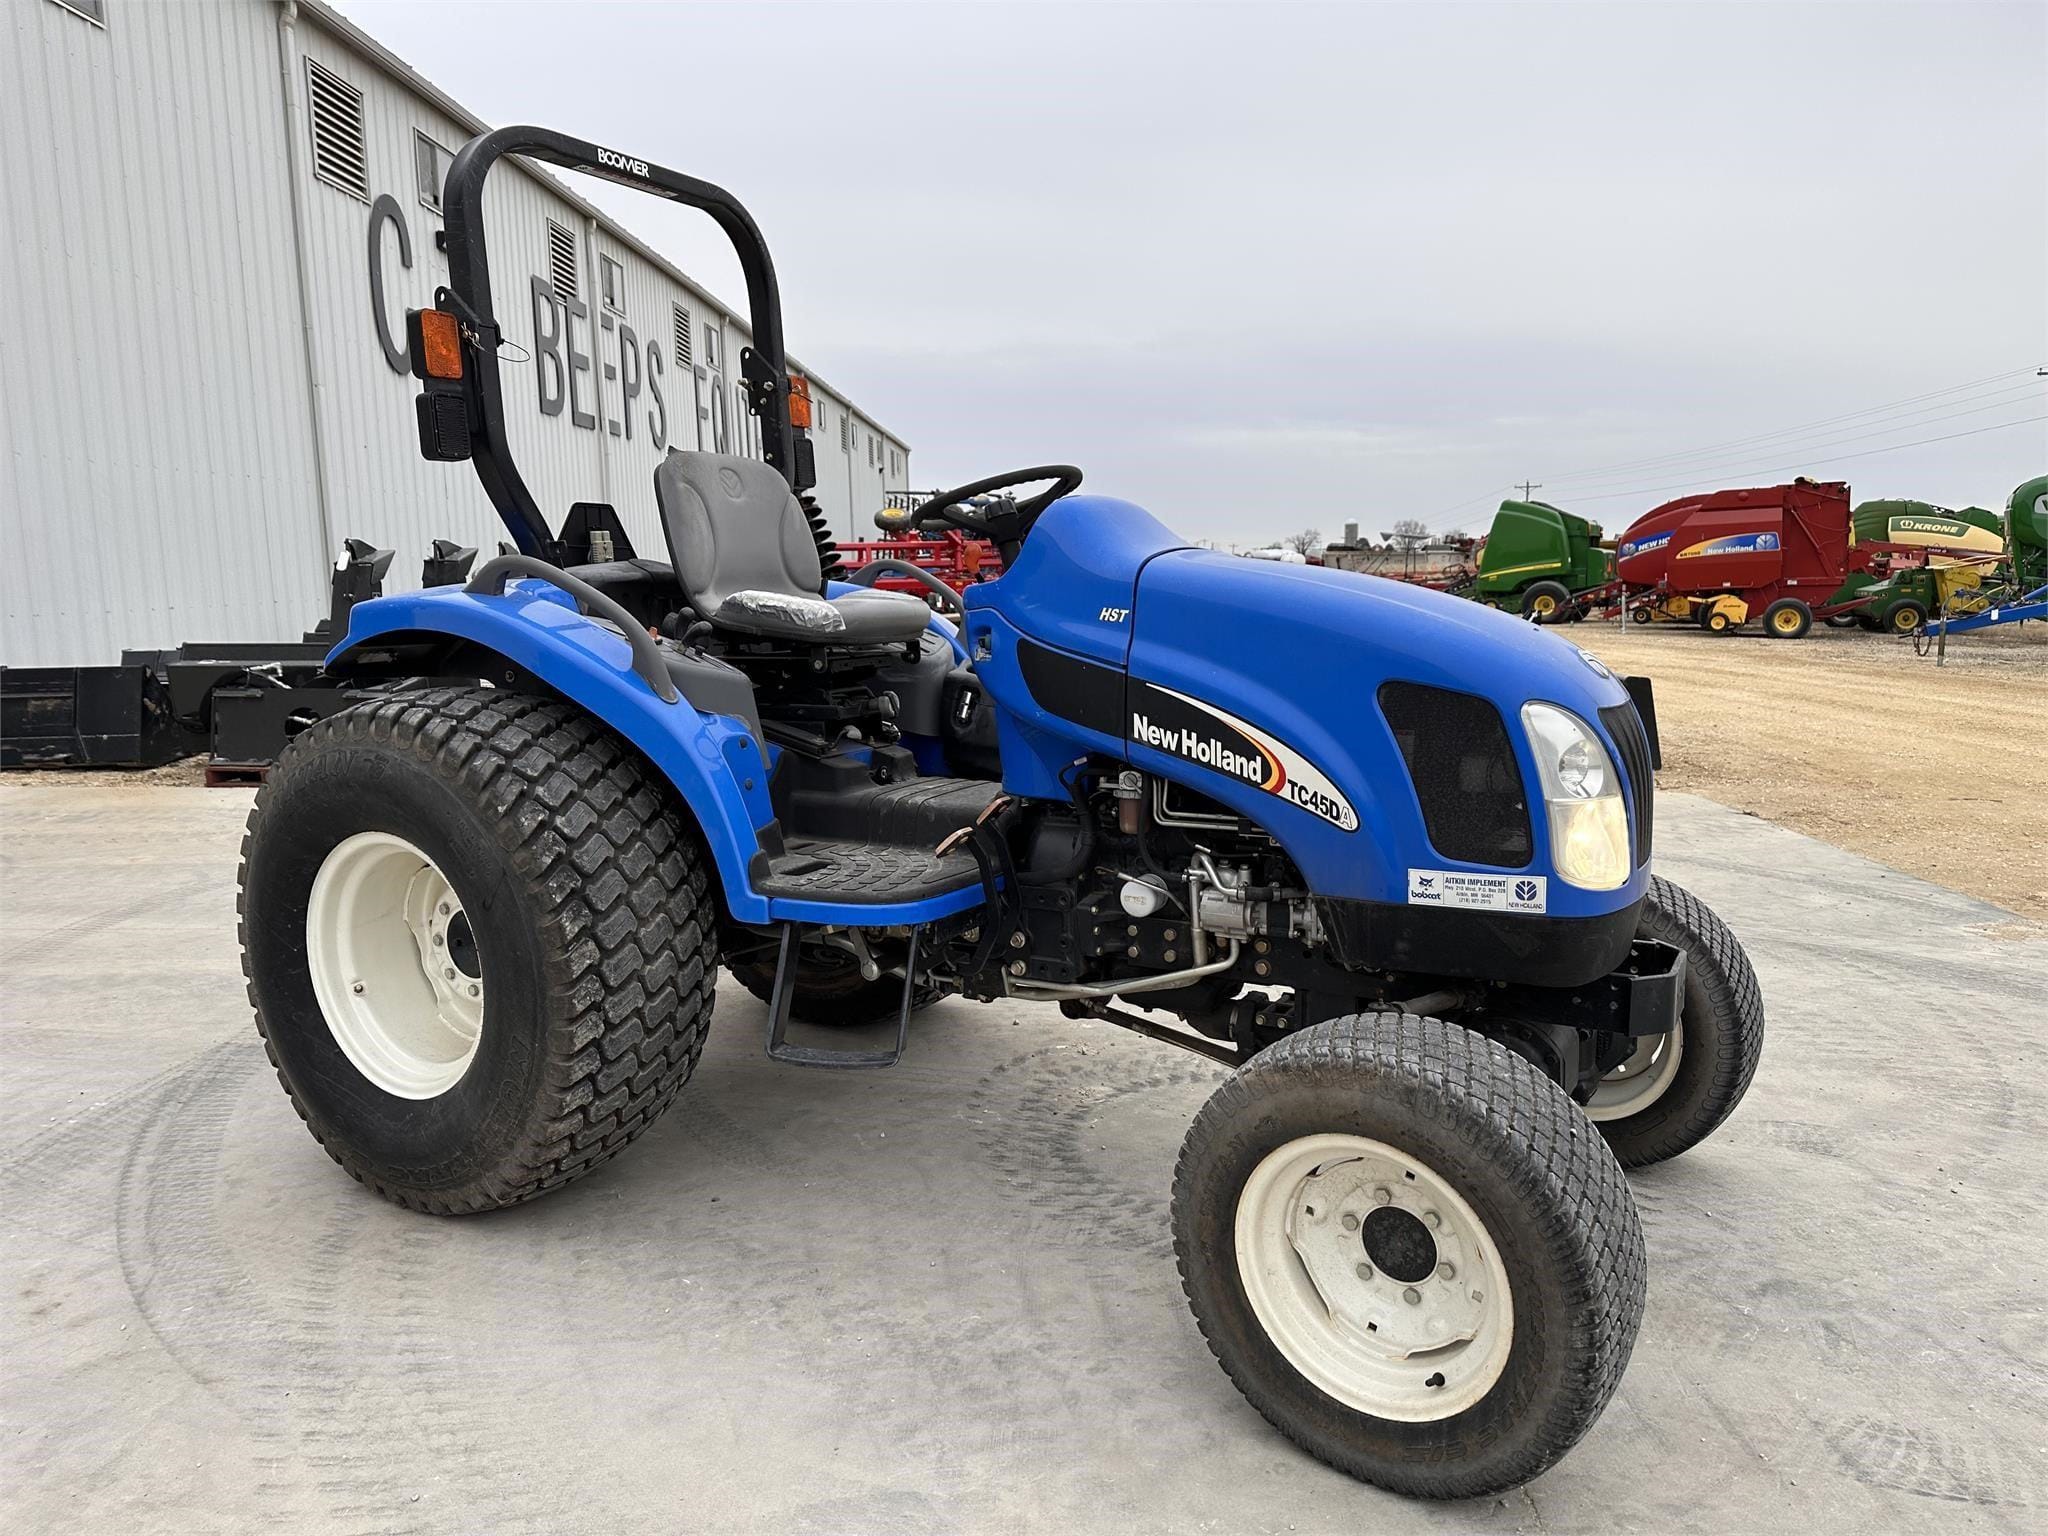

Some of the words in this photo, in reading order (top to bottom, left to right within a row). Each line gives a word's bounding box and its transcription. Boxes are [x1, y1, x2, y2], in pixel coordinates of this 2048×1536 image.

[597, 148, 650, 178] BOOMER
[1913, 523, 1959, 533] KRONE
[1725, 545, 1754, 553] Holland
[1099, 608, 1128, 623] HST
[1133, 713, 1180, 752] New
[1182, 728, 1262, 784] Holland
[1445, 877, 1466, 885] AITKIN
[1467, 879, 1506, 888] IMPLEMENT
[1411, 890, 1442, 900] bobcat
